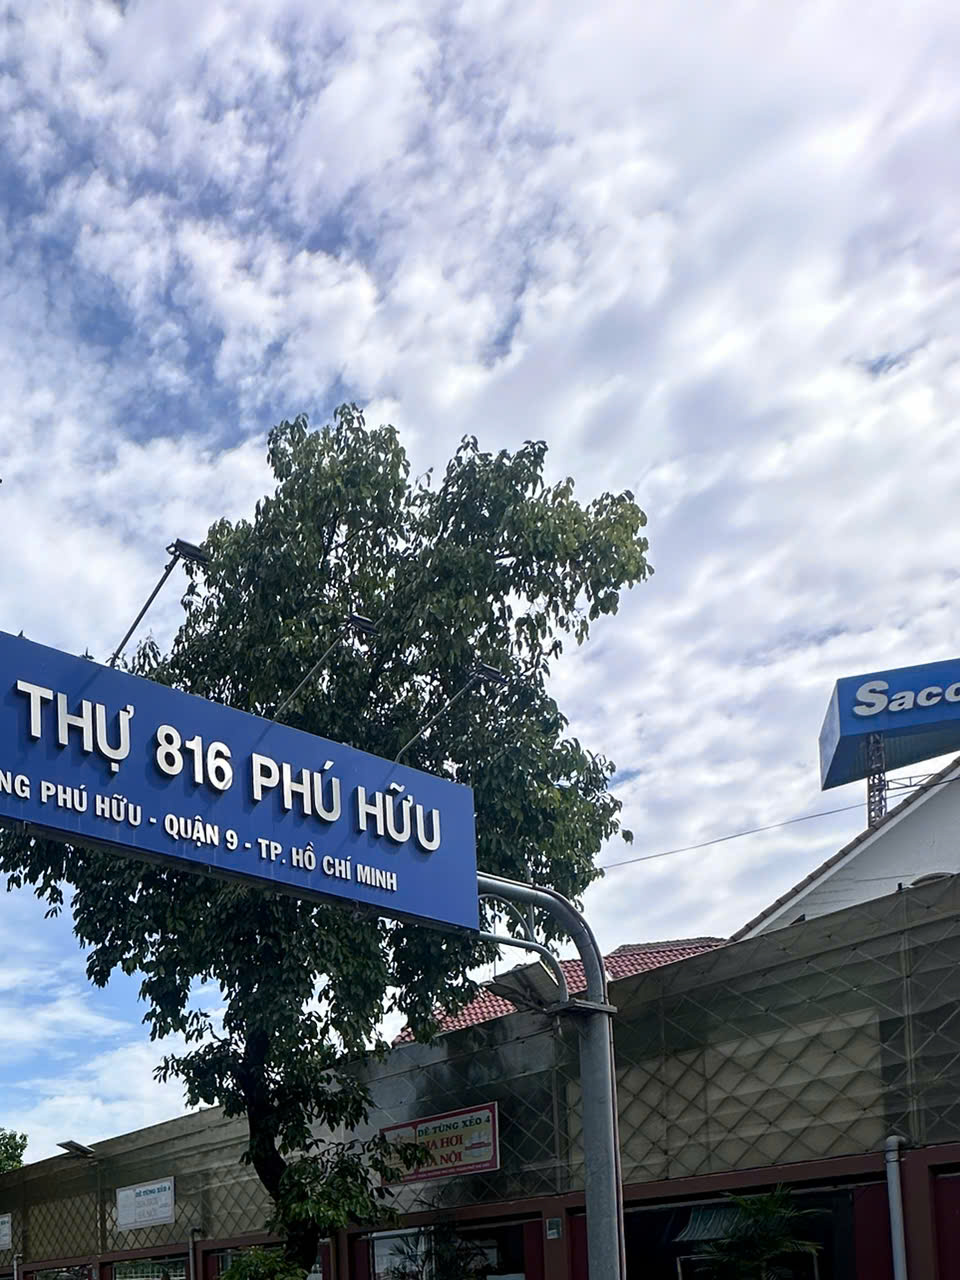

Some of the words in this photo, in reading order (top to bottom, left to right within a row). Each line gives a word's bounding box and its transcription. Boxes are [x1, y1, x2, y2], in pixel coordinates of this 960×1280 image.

[16, 679, 135, 773] THỰ
[156, 724, 234, 791] 816
[251, 752, 342, 823] PHÚ
[357, 782, 441, 851] HỮU
[41, 780, 88, 812] PHÚ
[95, 793, 142, 827] HỮU
[164, 813, 220, 847] QUẬN
[225, 829, 239, 850] 9
[257, 838, 287, 864] TP.
[292, 842, 317, 871] HỒ
[322, 855, 352, 880] CHÍ
[357, 863, 398, 892] MINH
